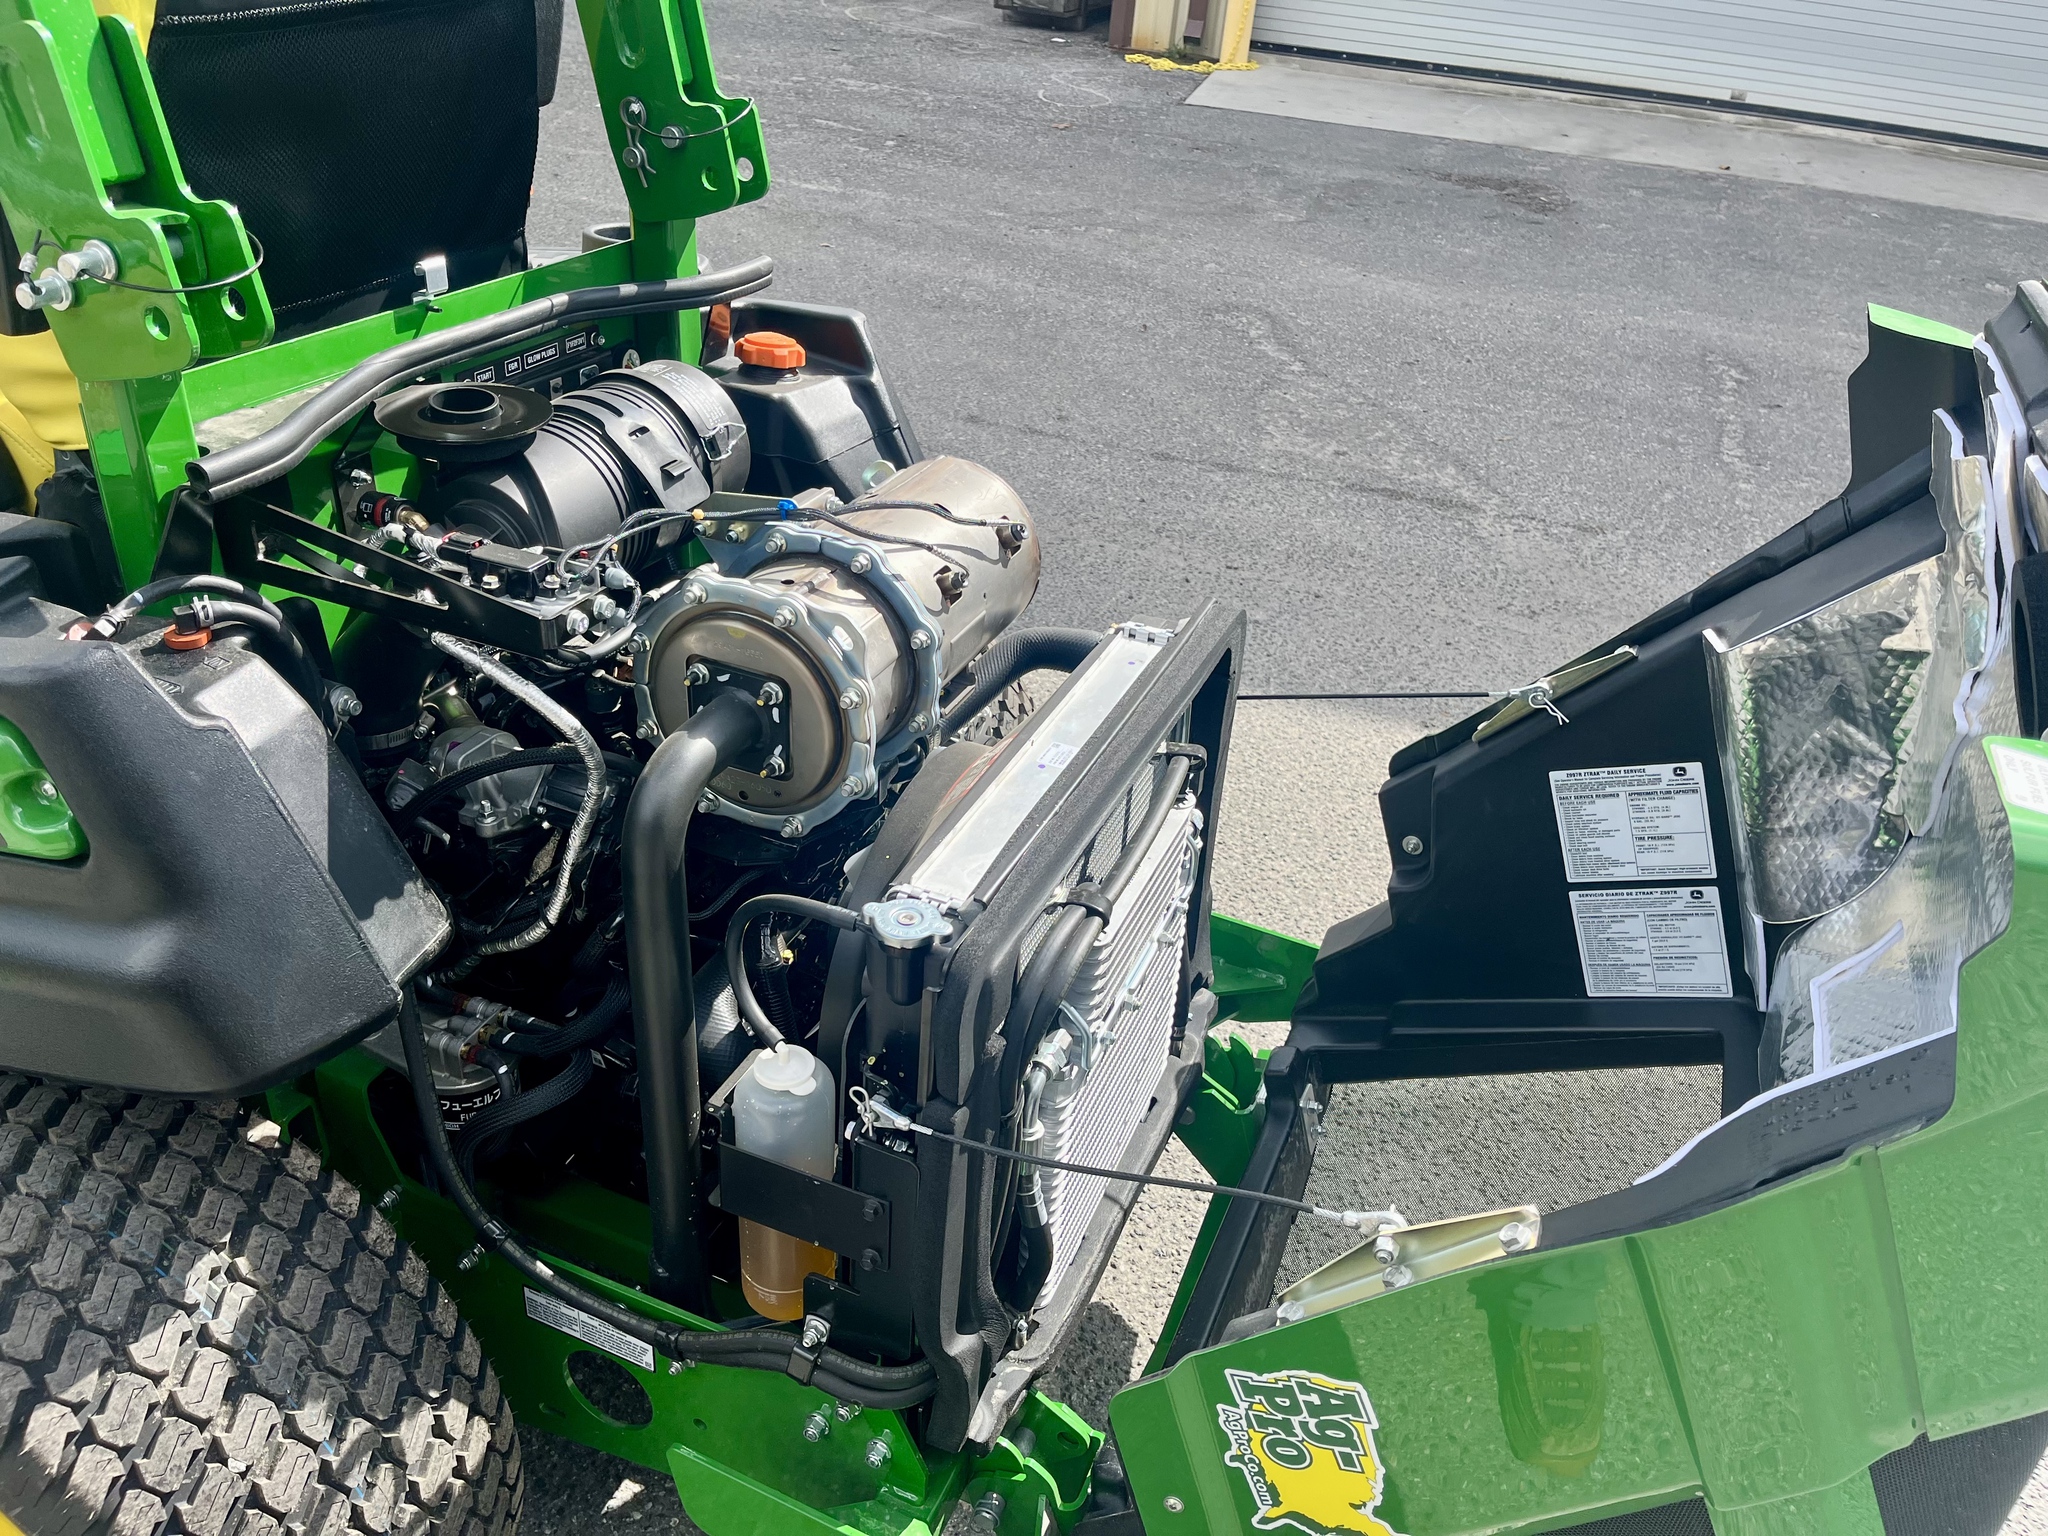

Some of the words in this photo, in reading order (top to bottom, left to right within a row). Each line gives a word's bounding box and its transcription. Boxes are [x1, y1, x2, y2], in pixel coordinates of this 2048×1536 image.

[527, 352, 540, 364] GLOW
[541, 347, 556, 358] PLUGS
[508, 362, 518, 371] EGR
[476, 371, 492, 382] START
[440, 1088, 501, 1110] フューエルフ
[1231, 1374, 1313, 1470] Pro
[1222, 1408, 1274, 1507] AgProCo.com
